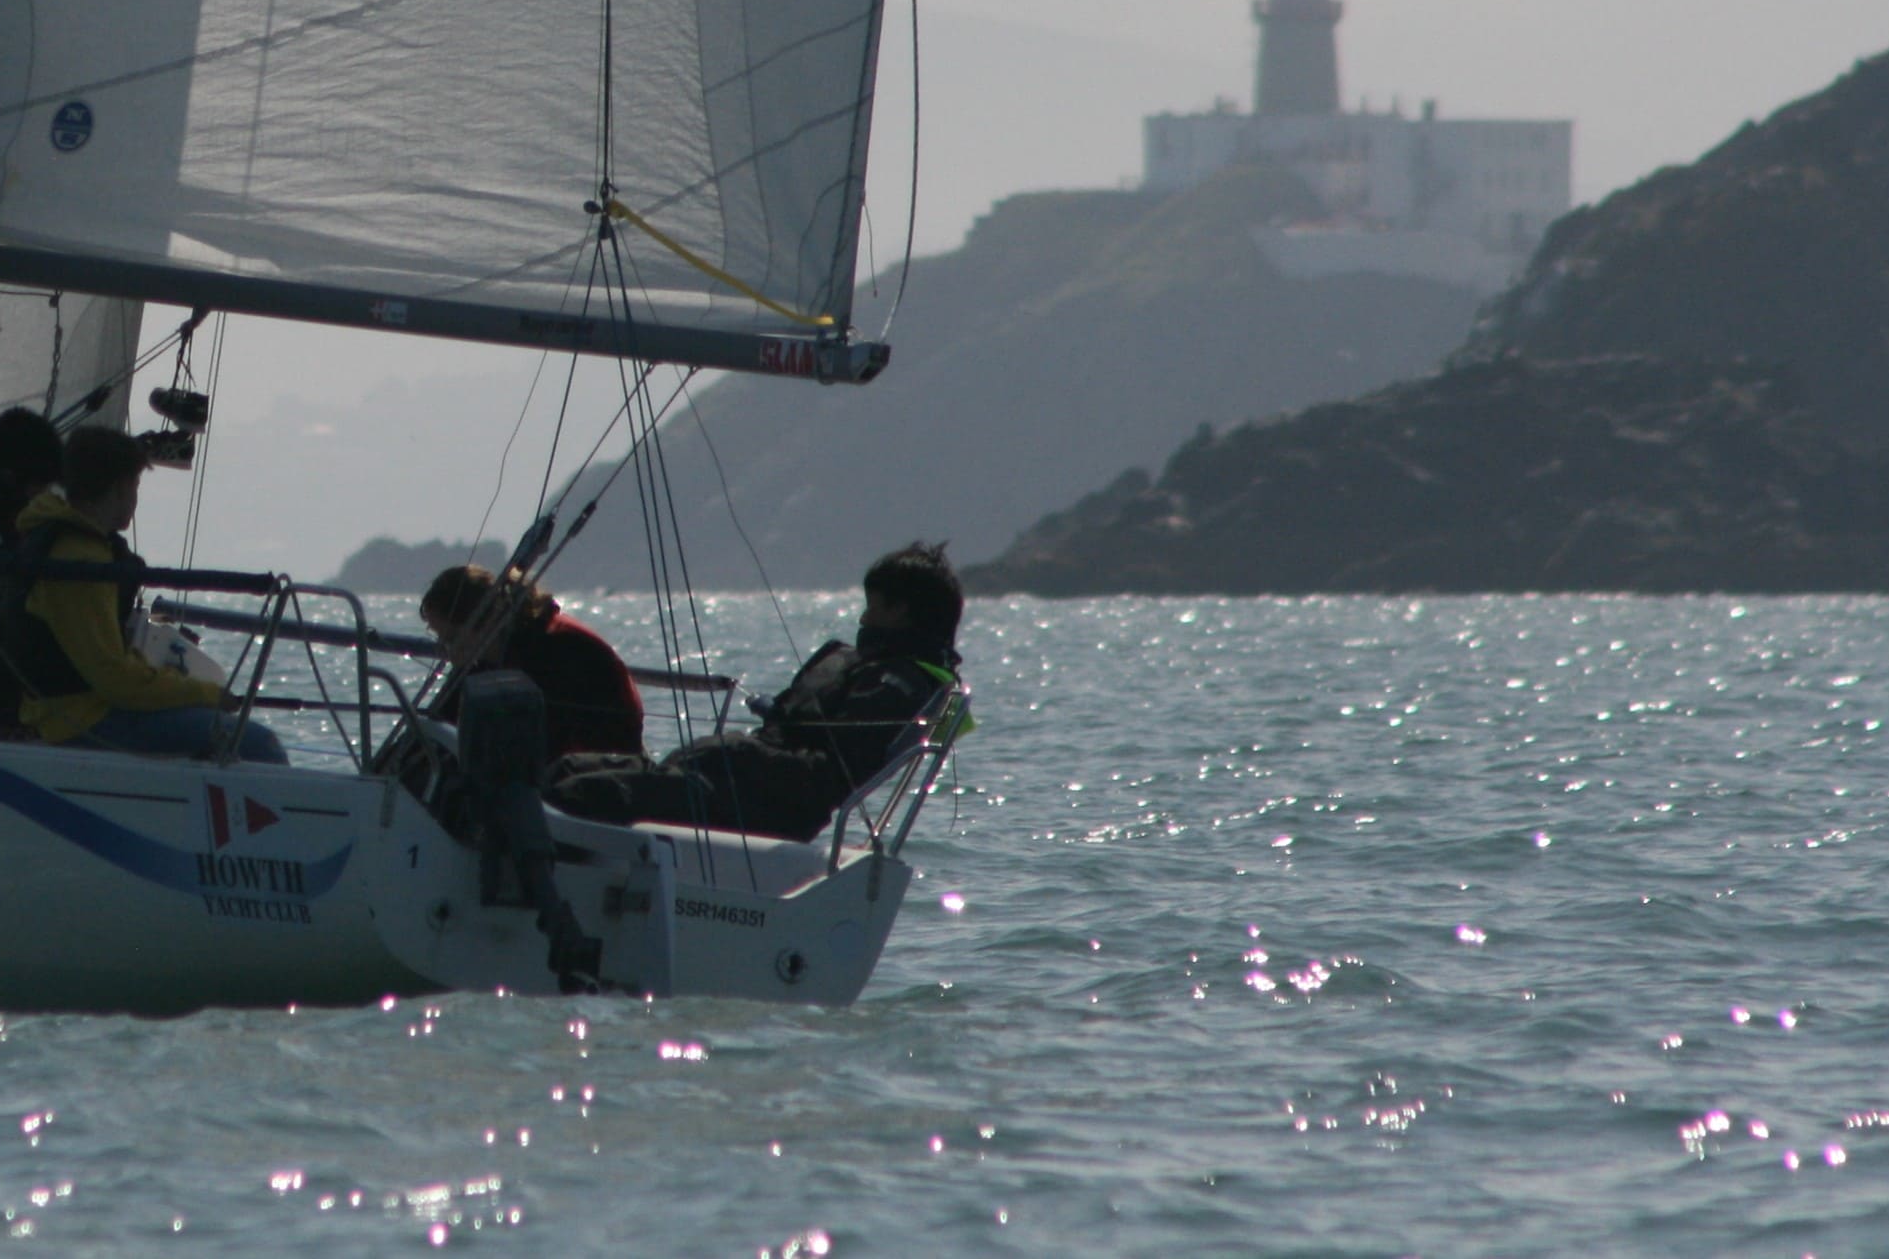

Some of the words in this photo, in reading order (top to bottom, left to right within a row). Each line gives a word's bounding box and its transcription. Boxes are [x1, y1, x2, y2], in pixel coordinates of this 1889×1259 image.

[195, 852, 306, 894] HOWTH
[202, 893, 262, 920] YACHT
[264, 899, 312, 925] CLUB
